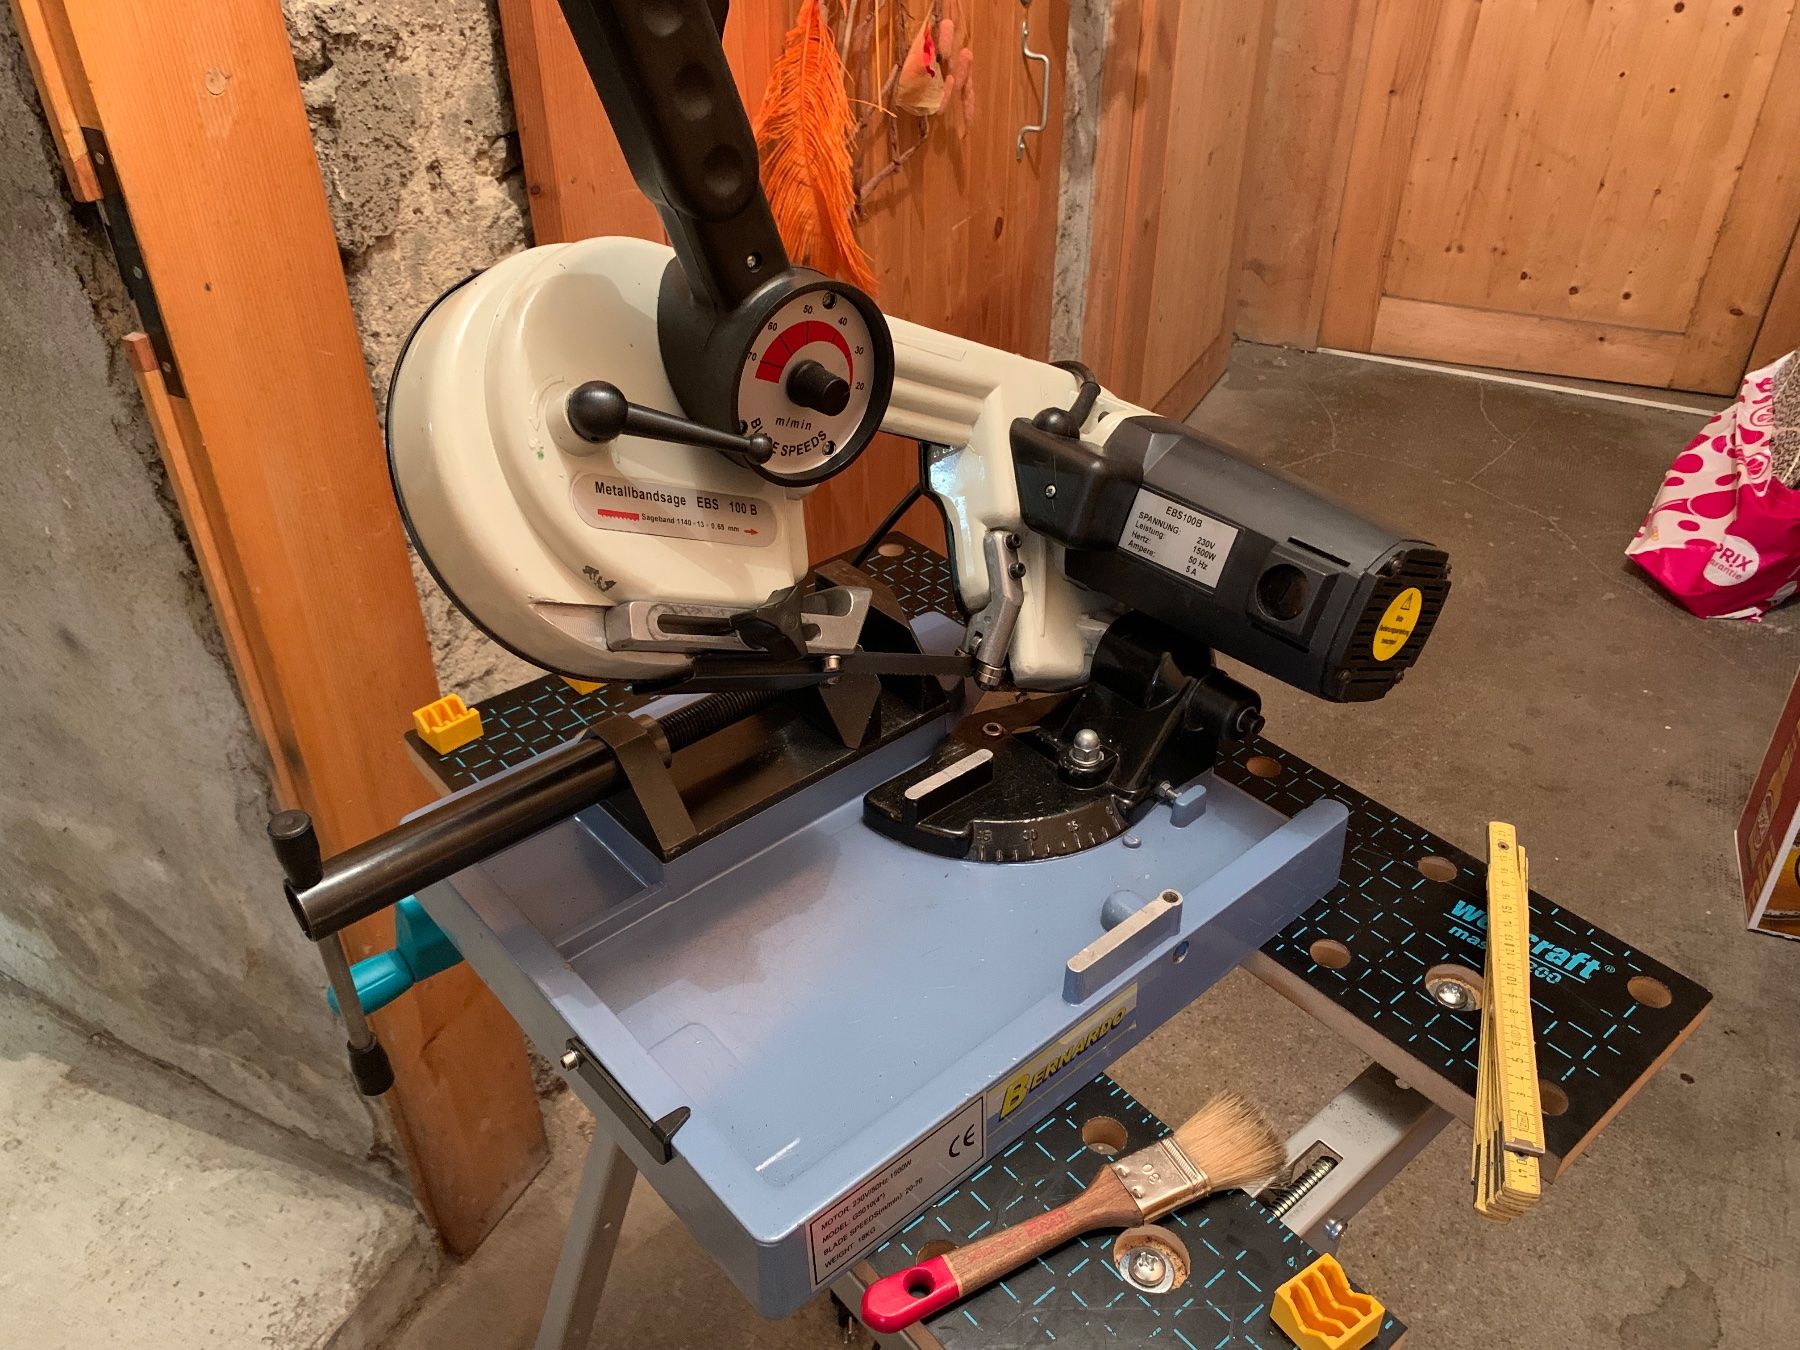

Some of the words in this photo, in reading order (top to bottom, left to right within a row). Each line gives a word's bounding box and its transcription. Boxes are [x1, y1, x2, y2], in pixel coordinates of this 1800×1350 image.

[803, 304, 813, 314] 50
[767, 322, 778, 331] 60
[838, 317, 848, 326] 40
[747, 351, 757, 361] 70
[854, 346, 864, 355] 30
[855, 382, 865, 390] 20
[775, 417, 812, 431] m/min
[781, 430, 827, 457] SPEEDS
[595, 481, 687, 507] Metallbandsage
[697, 496, 719, 510] EBS
[729, 501, 747, 514] 100
[750, 504, 758, 516] B
[677, 518, 692, 526] 1140
[1165, 506, 1203, 528] EBS100B
[1138, 511, 1182, 536] SPANNUNG:
[1196, 536, 1216, 550] 230V
[1193, 545, 1217, 562] 1500W
[1185, 565, 1191, 573] 5
[1191, 568, 1197, 576] A
[1188, 555, 1197, 565] 50
[1198, 561, 1208, 571] Hz
[1710, 559, 1742, 580] arantie
[1451, 899, 1601, 980] woraft
[998, 1006, 1127, 1122] BERNARDO
[890, 1159, 912, 1179] 1500W
[823, 1234, 848, 1256] BLADE
